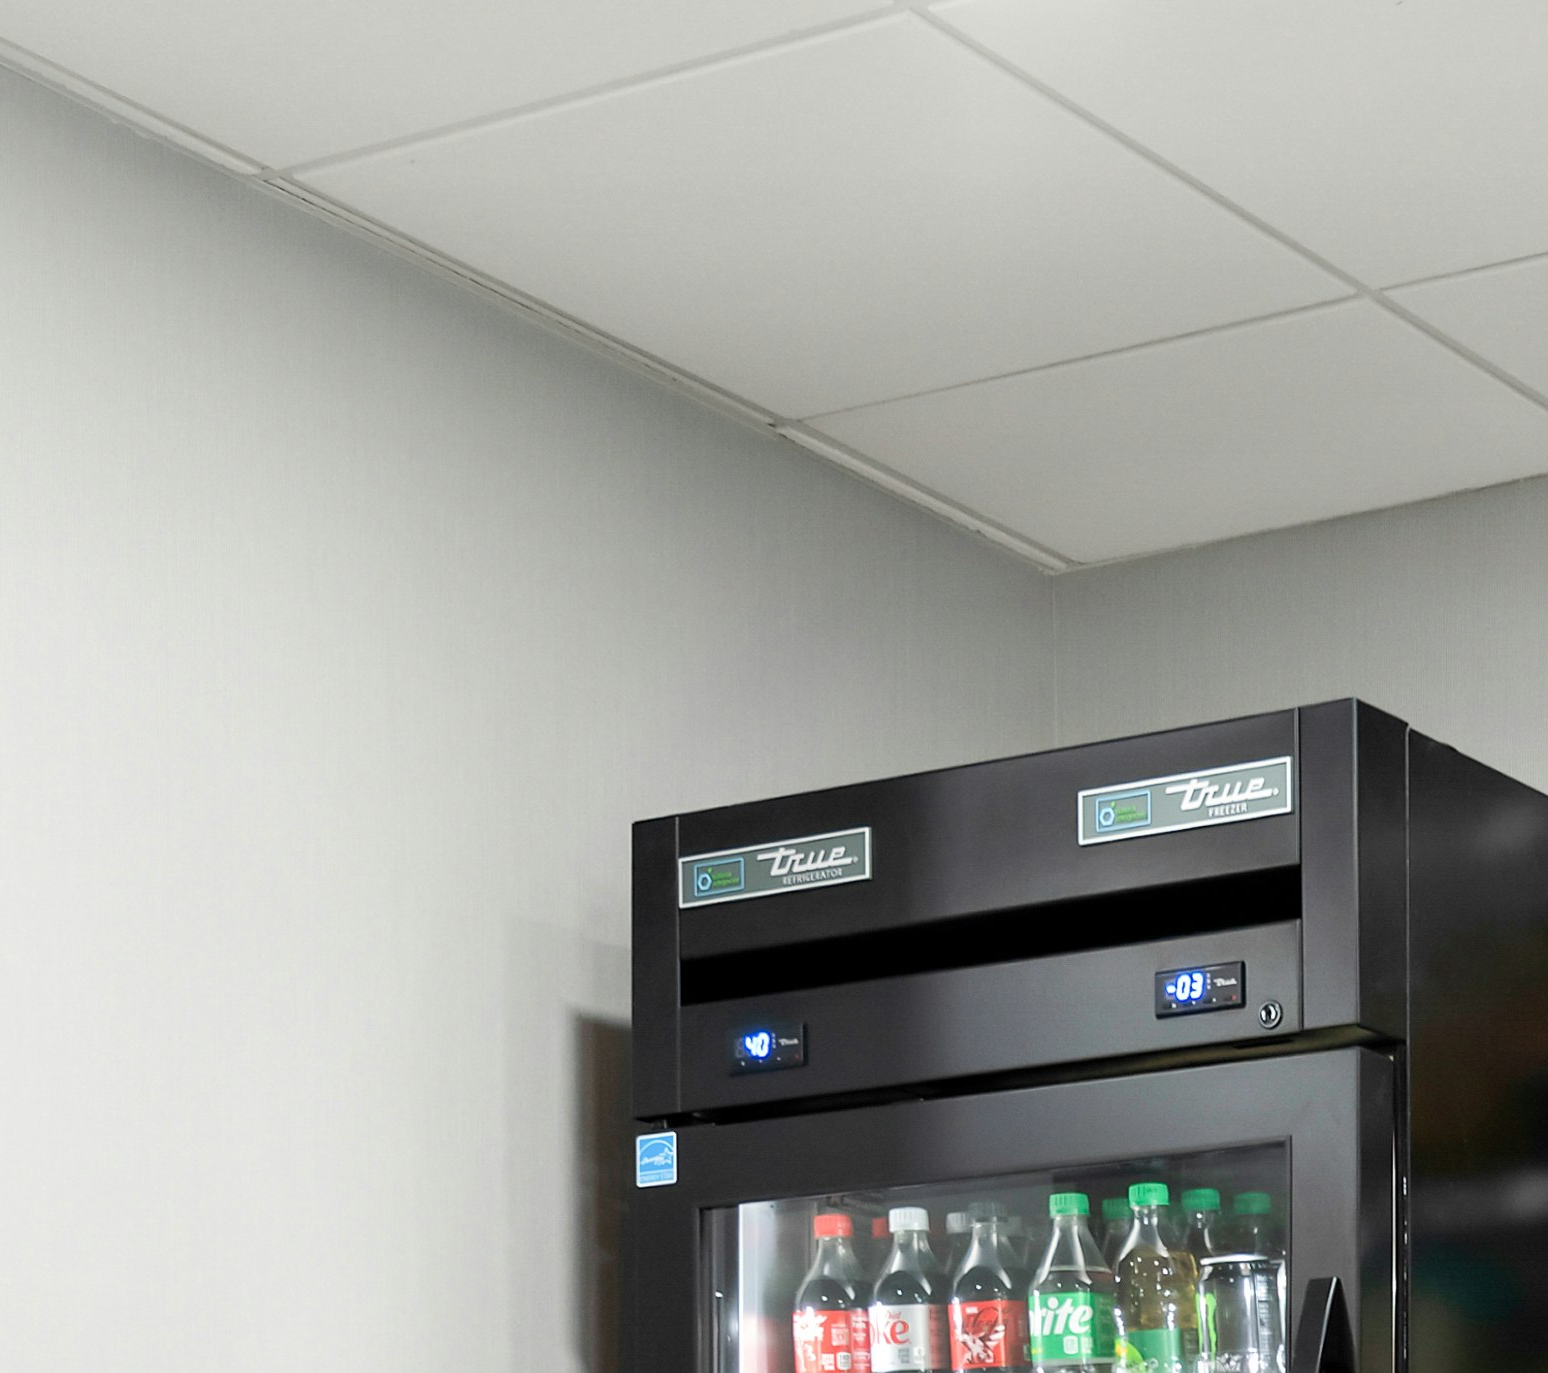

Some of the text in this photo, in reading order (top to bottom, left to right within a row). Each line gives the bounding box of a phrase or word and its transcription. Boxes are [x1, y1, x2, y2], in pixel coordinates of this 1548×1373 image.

[1208, 801, 1248, 817] FREEZER
[782, 868, 843, 885] REFRIGERATOR
[745, 1032, 770, 1057] 40
